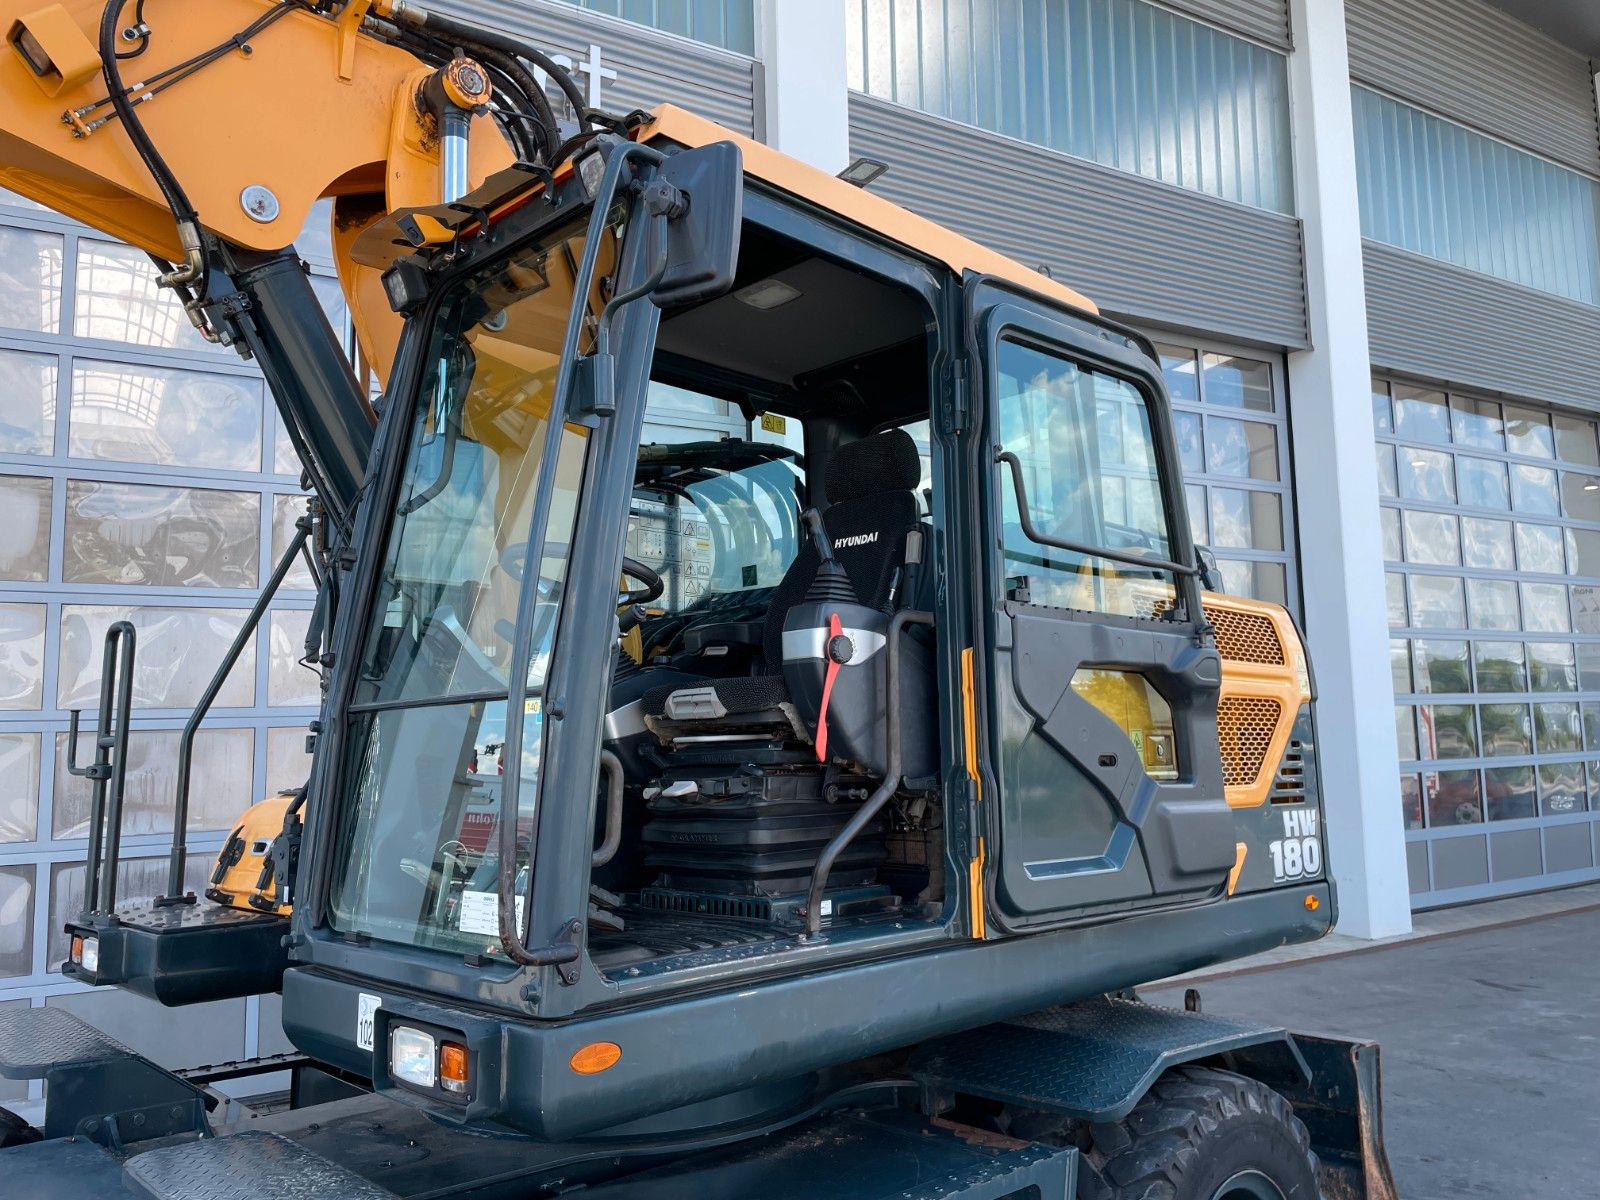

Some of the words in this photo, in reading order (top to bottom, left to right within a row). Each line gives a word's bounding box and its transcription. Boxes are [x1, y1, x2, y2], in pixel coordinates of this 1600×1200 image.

[834, 531, 879, 549] HYUNDAI
[1283, 809, 1316, 837] HW
[1269, 837, 1321, 881] 180
[360, 1018, 373, 1046] 102
